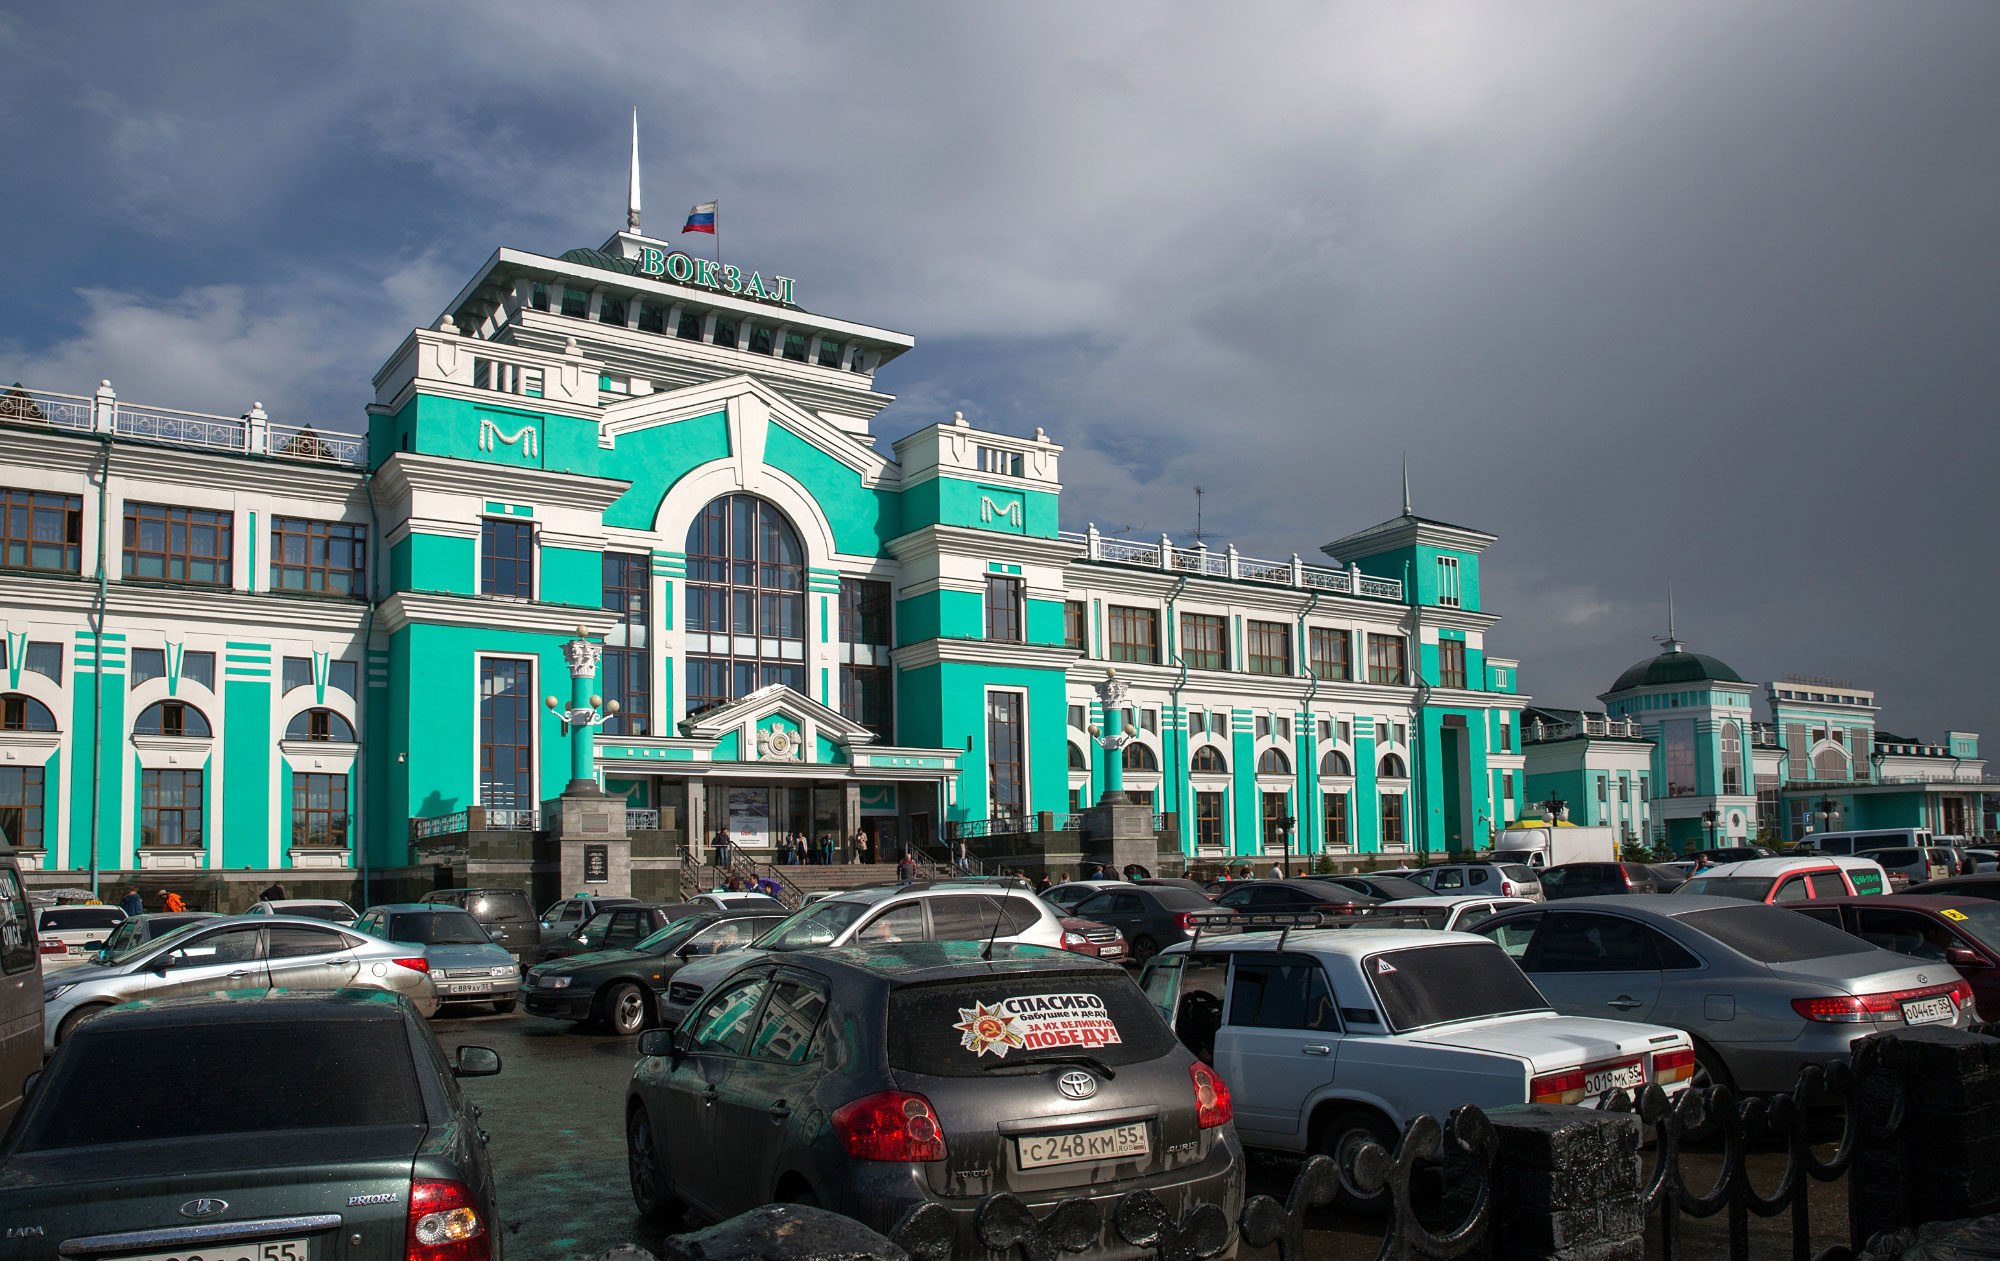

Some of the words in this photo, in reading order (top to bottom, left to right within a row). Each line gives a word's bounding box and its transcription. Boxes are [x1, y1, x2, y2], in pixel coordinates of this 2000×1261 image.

[641, 246, 796, 304] ВОКЗАЛ
[1380, 963, 1391, 971] Ш
[1005, 995, 1103, 1014] СПАСИБО
[1020, 1011, 1070, 1021] бабушке
[1071, 1010, 1080, 1018] и
[1080, 1010, 1107, 1019] деду
[1027, 1023, 1042, 1032] ЗА
[1043, 1021, 1060, 1031] ИХ
[1060, 1020, 1114, 1029] ВЕЛИКУЮ
[1024, 1028, 1120, 1048] ПОБЕДУ!
[1629, 1065, 1641, 1079] 55
[1117, 1127, 1138, 1145] 55
[1167, 1141, 1199, 1153] AURIS
[956, 1169, 991, 1178] TOYOTA
[346, 1193, 399, 1207] PRIORA
[6, 1225, 45, 1239] LADA
[264, 1243, 297, 1261] 55
